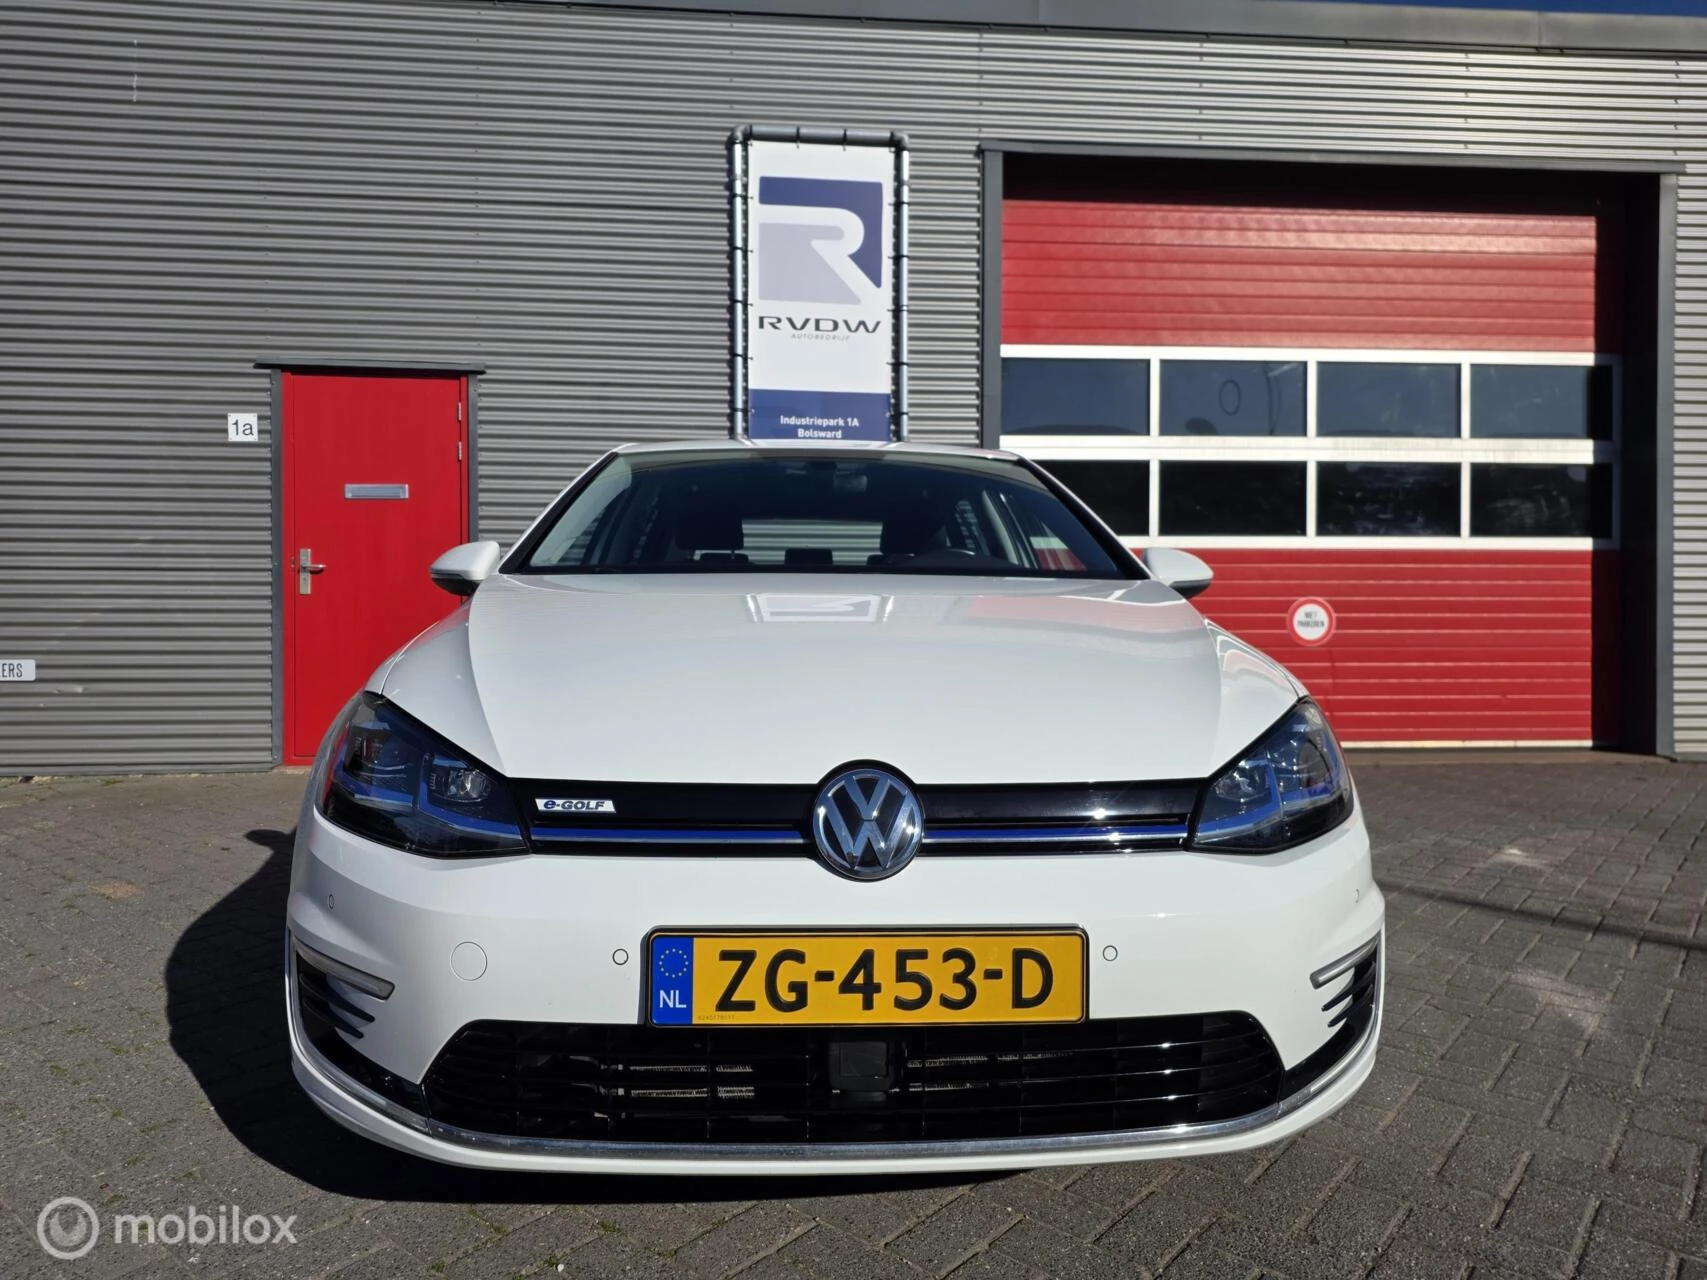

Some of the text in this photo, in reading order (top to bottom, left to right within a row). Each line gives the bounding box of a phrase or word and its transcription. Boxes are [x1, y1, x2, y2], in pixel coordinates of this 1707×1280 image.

[758, 315, 881, 333] RVDW
[231, 419, 254, 436] 1a
[780, 415, 859, 427] Industriepark 1A
[797, 428, 842, 439] Bolsward
[0, 663, 23, 678] ERS
[543, 800, 606, 810] e-GOLF
[715, 947, 1054, 1013] ZG-453-D
[659, 989, 688, 1008] NL
